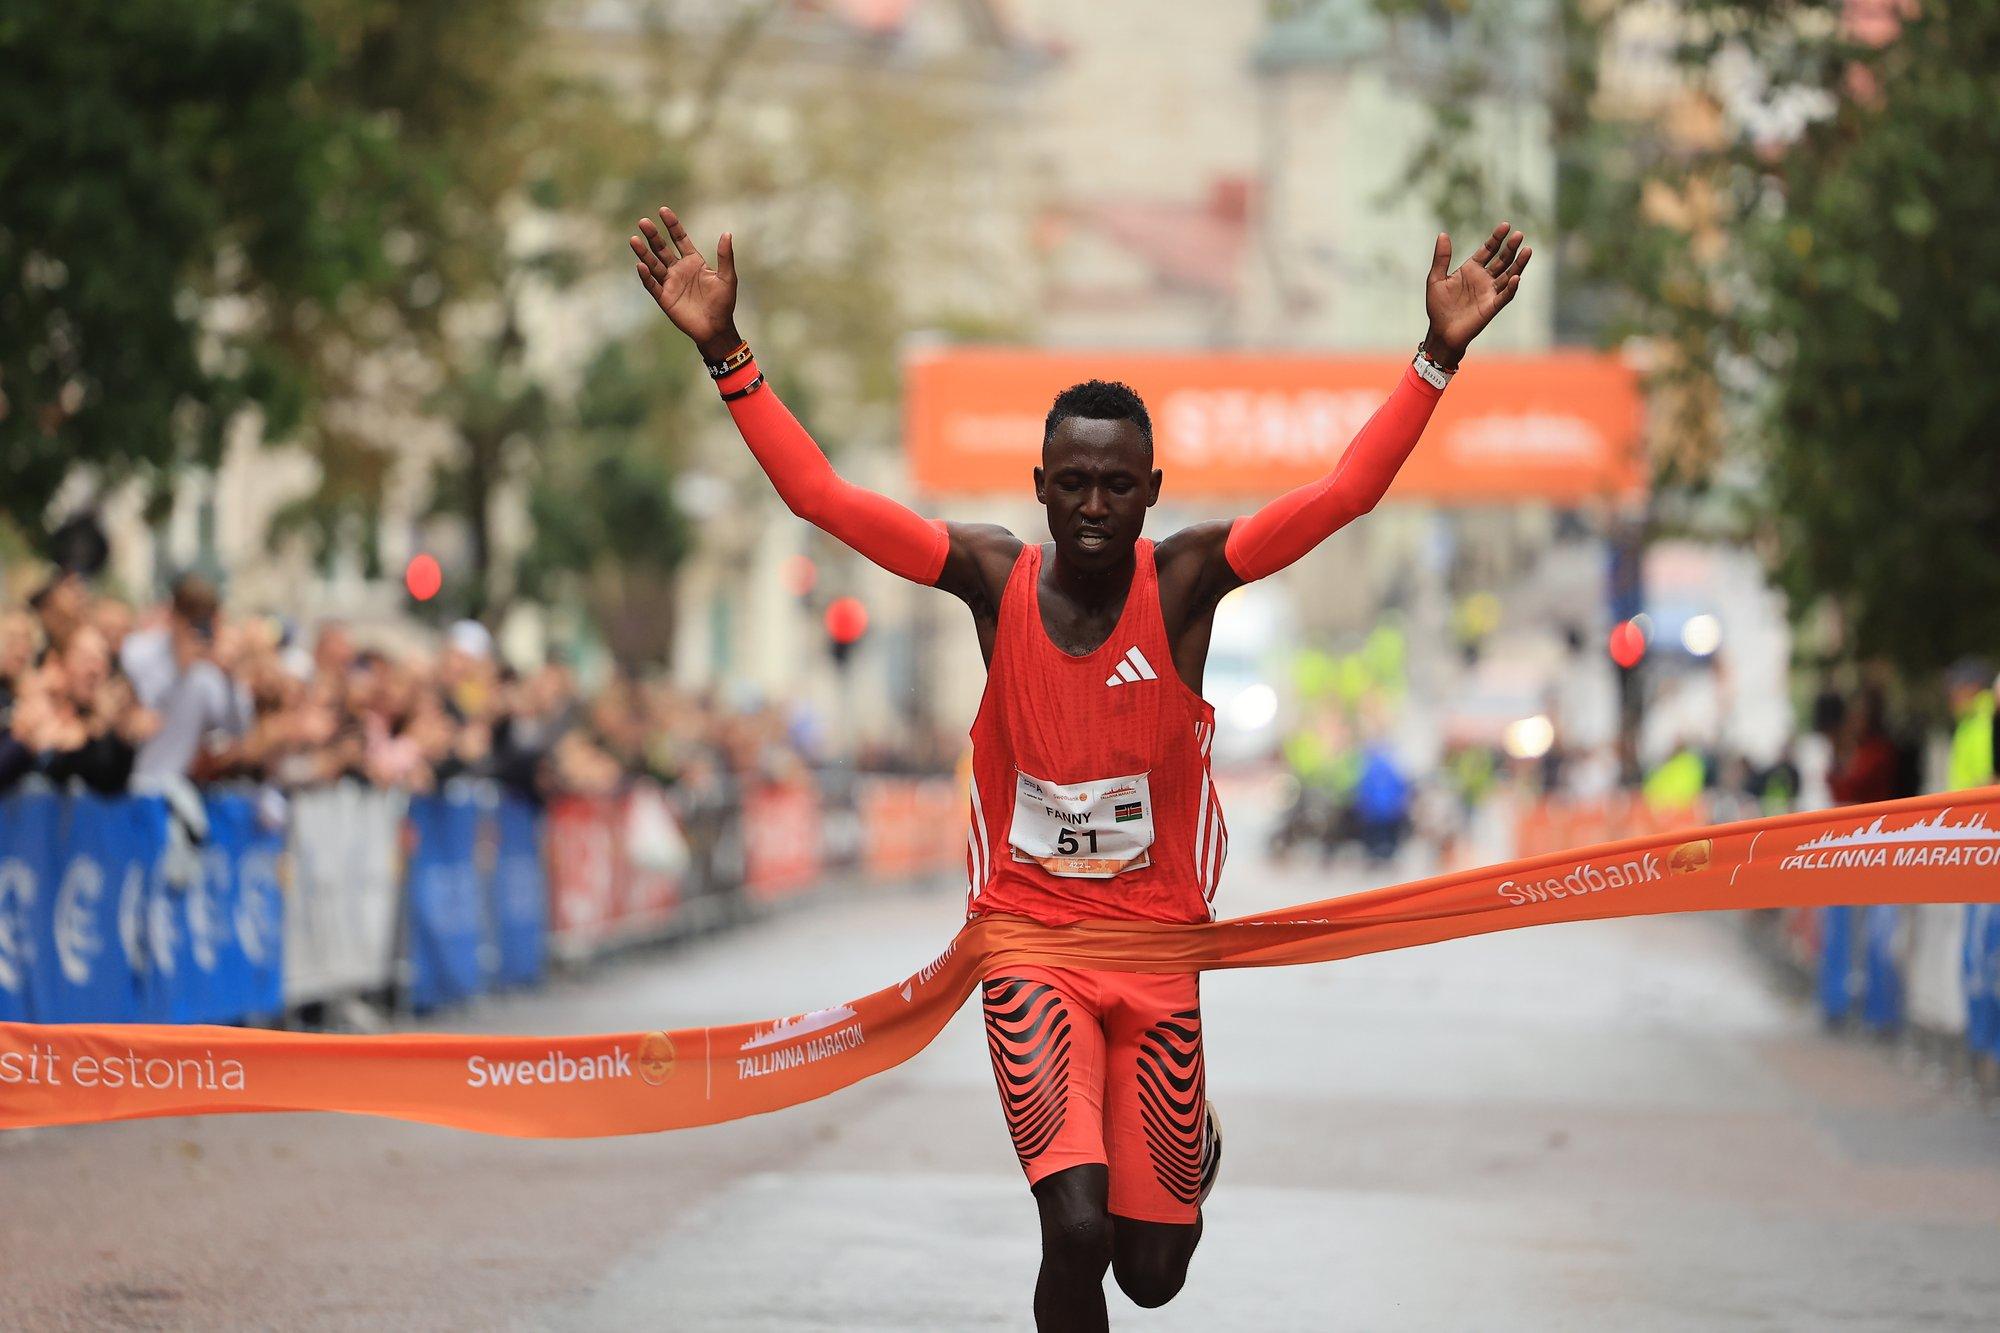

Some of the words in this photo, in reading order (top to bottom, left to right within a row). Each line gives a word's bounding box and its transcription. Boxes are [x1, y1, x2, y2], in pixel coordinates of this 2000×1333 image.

[1045, 806, 1092, 824] FANNY
[1057, 827, 1098, 855] 51
[1780, 848, 1886, 870] TALLINNA
[1497, 852, 1662, 906] Swedbank
[0, 1044, 61, 1085] sit
[72, 1049, 245, 1091] estonia
[466, 1045, 632, 1088] Swedbank
[736, 1045, 806, 1080] TALLINNA
[806, 1022, 865, 1063] MARATON
